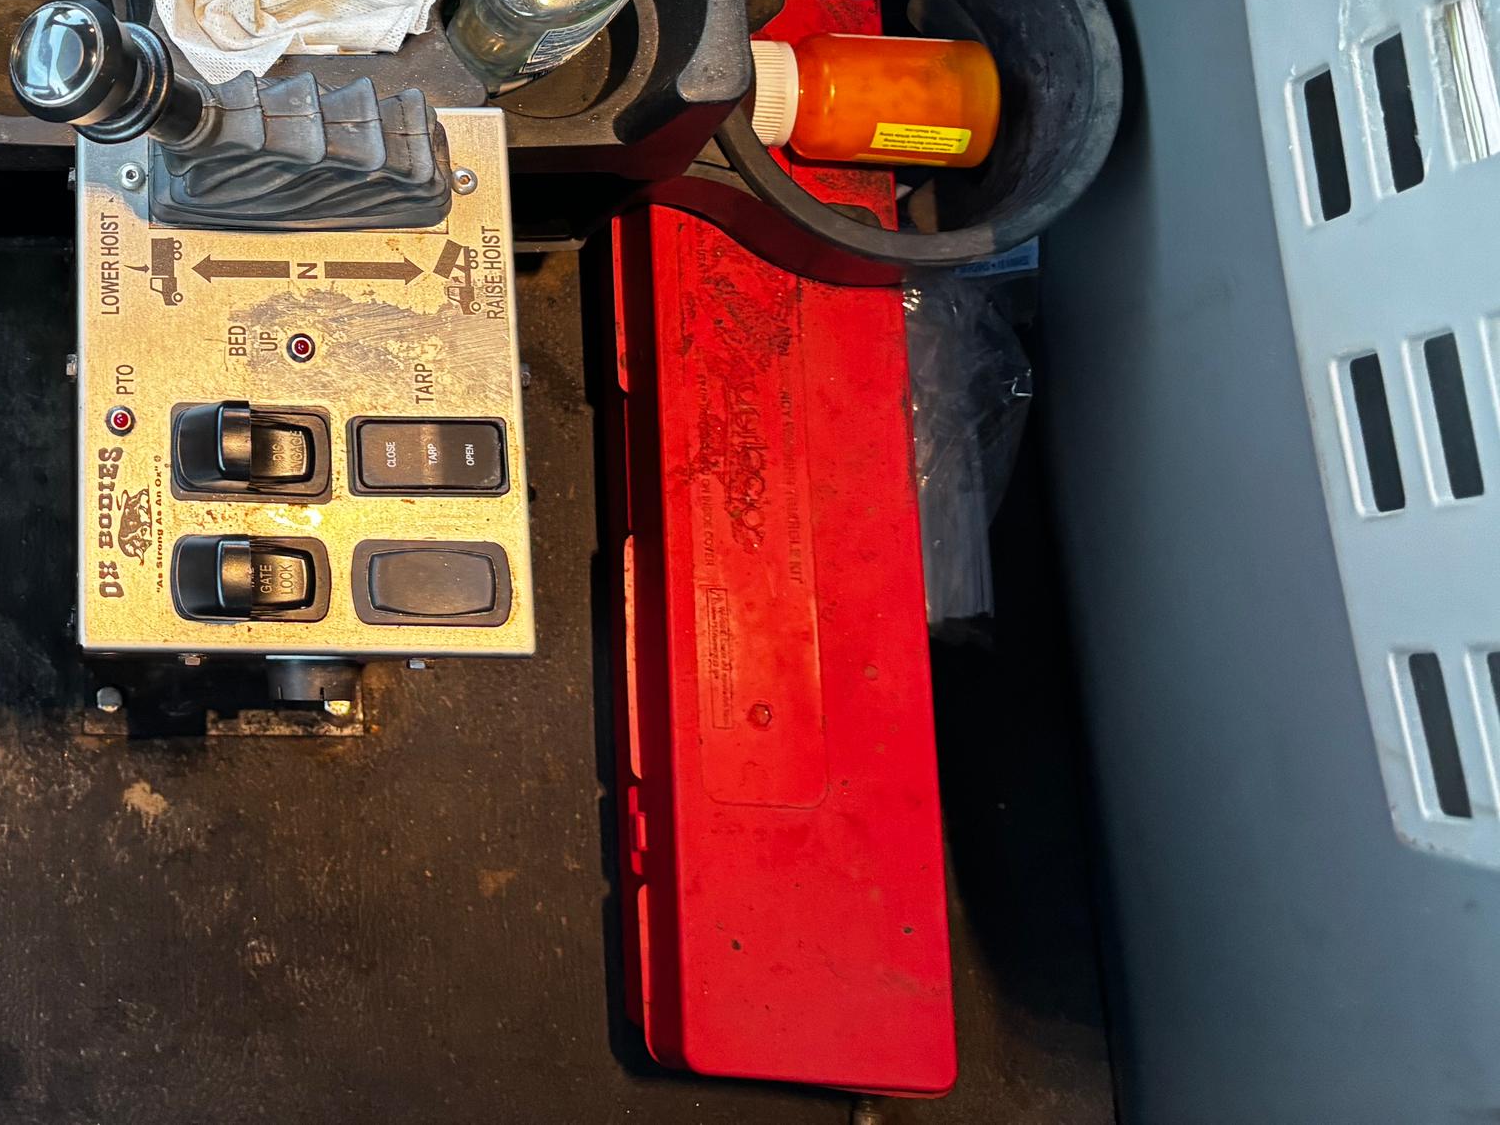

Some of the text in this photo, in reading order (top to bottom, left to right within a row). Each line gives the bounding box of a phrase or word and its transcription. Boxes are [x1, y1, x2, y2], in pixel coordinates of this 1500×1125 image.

[101, 212, 120, 315] LOWER HOIST
[297, 262, 318, 279] N
[482, 225, 506, 320] RAISE HOIST
[228, 325, 247, 357] BED
[259, 331, 278, 352] UP
[116, 364, 134, 395] PTO
[415, 362, 434, 404] TARP
[385, 441, 397, 468] CLOSE
[427, 443, 438, 465] TARP
[465, 443, 475, 466] OPEN
[155, 492, 162, 510] An
[98, 447, 125, 598] OX BODIES
[155, 510, 163, 525] As
[156, 528, 164, 568] Strong
[704, 530, 715, 567] COVER
[156, 574, 164, 593] "As
[260, 564, 273, 594] GATE
[279, 564, 293, 595] LOCK
[789, 560, 804, 584] KIT
